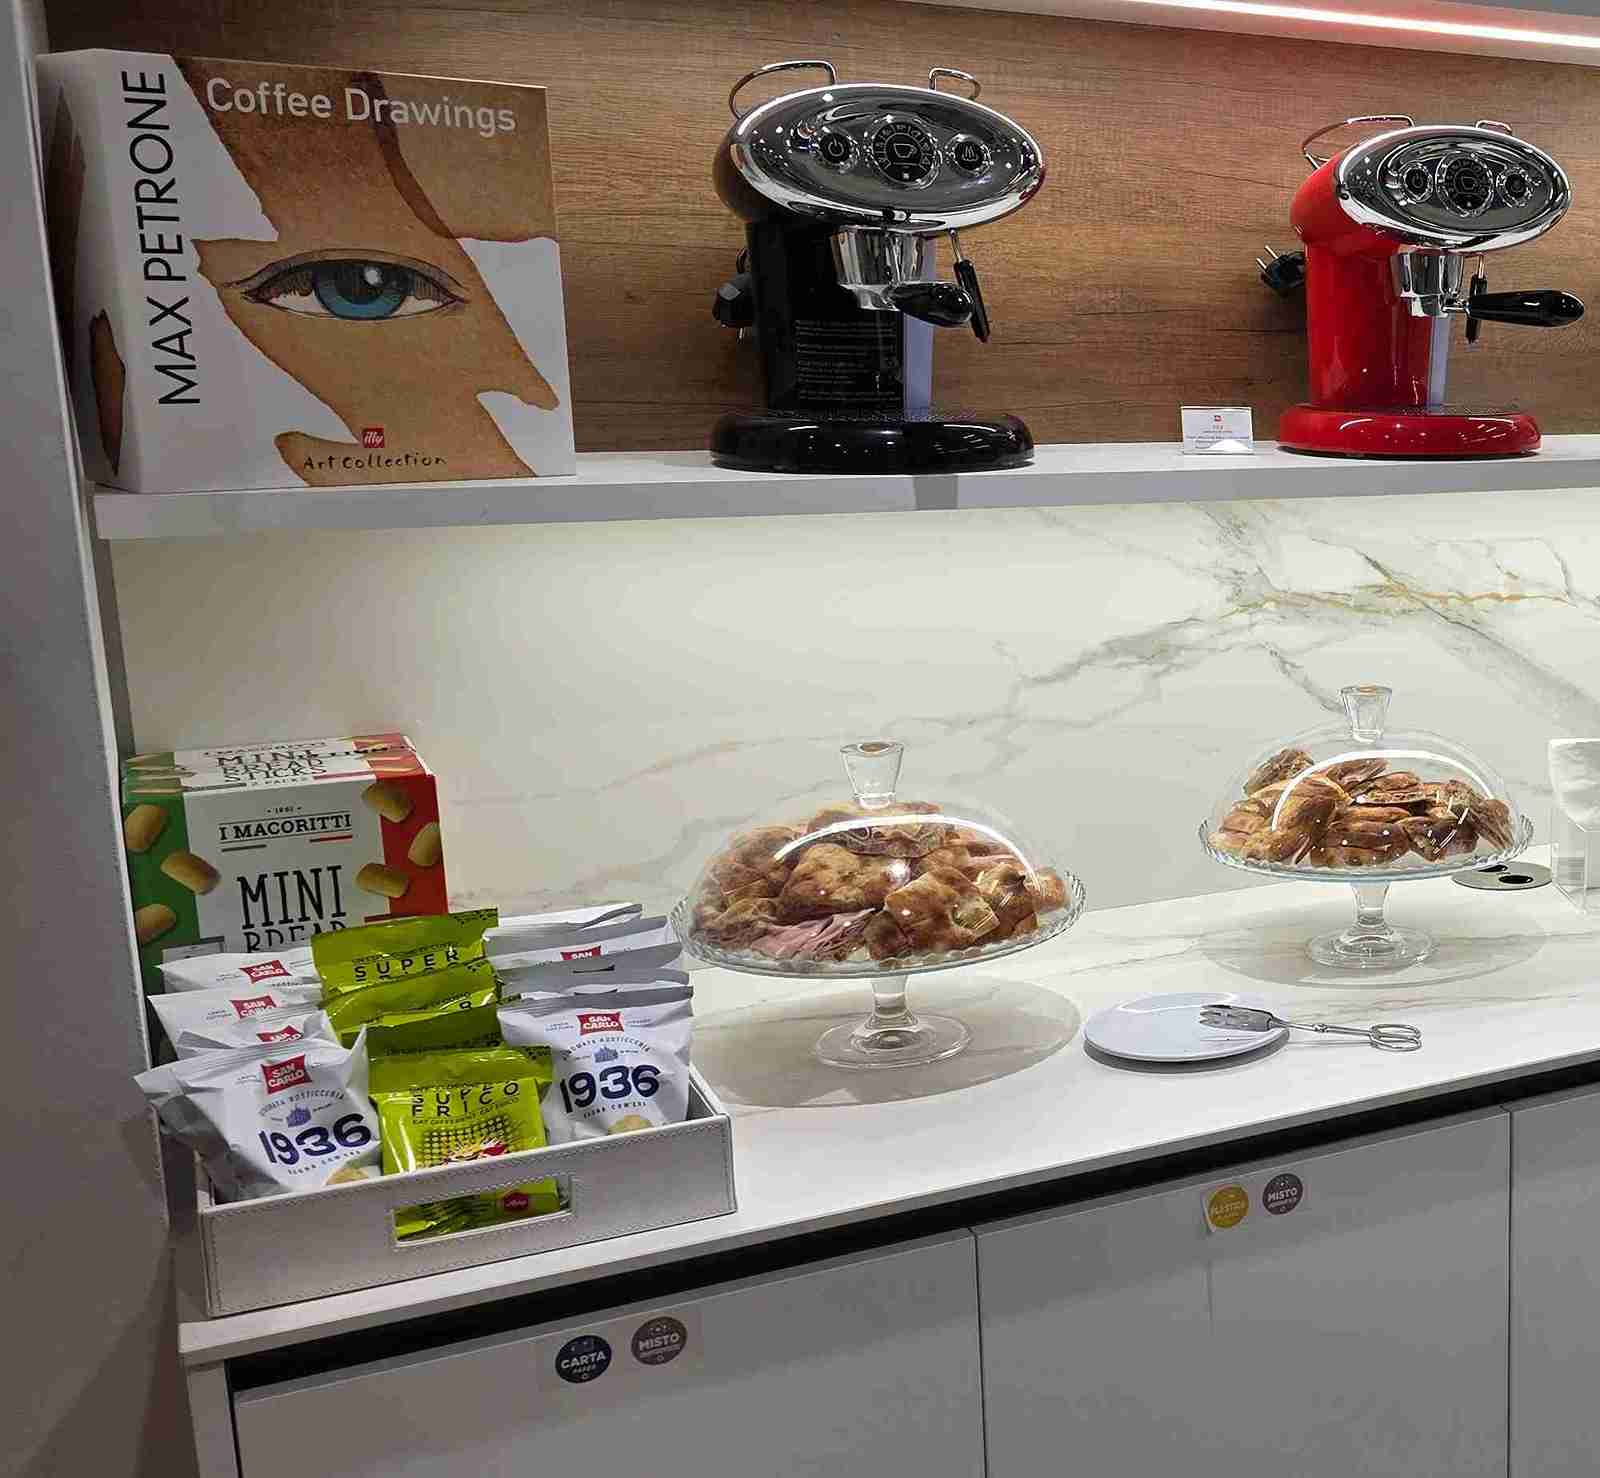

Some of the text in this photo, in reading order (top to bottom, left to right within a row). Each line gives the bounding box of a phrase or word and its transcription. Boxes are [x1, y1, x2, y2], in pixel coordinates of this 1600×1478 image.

[206, 78, 517, 138] Coffee Drawings
[122, 70, 200, 405] MAX PETRONE
[364, 431, 384, 447] illy
[304, 452, 448, 470] Art Collection
[219, 813, 352, 841] I MACORITTI
[236, 865, 347, 930] MINI
[353, 948, 459, 979] SUPER
[571, 950, 593, 959] SAN
[267, 1069, 306, 1089] CARLO
[271, 1062, 296, 1079] SAN
[559, 1064, 661, 1114] 1936
[258, 1113, 372, 1165] 1936
[1267, 1186, 1298, 1203] MISTO
[638, 1331, 681, 1351] MISTO
[560, 1350, 607, 1369] CARTA
